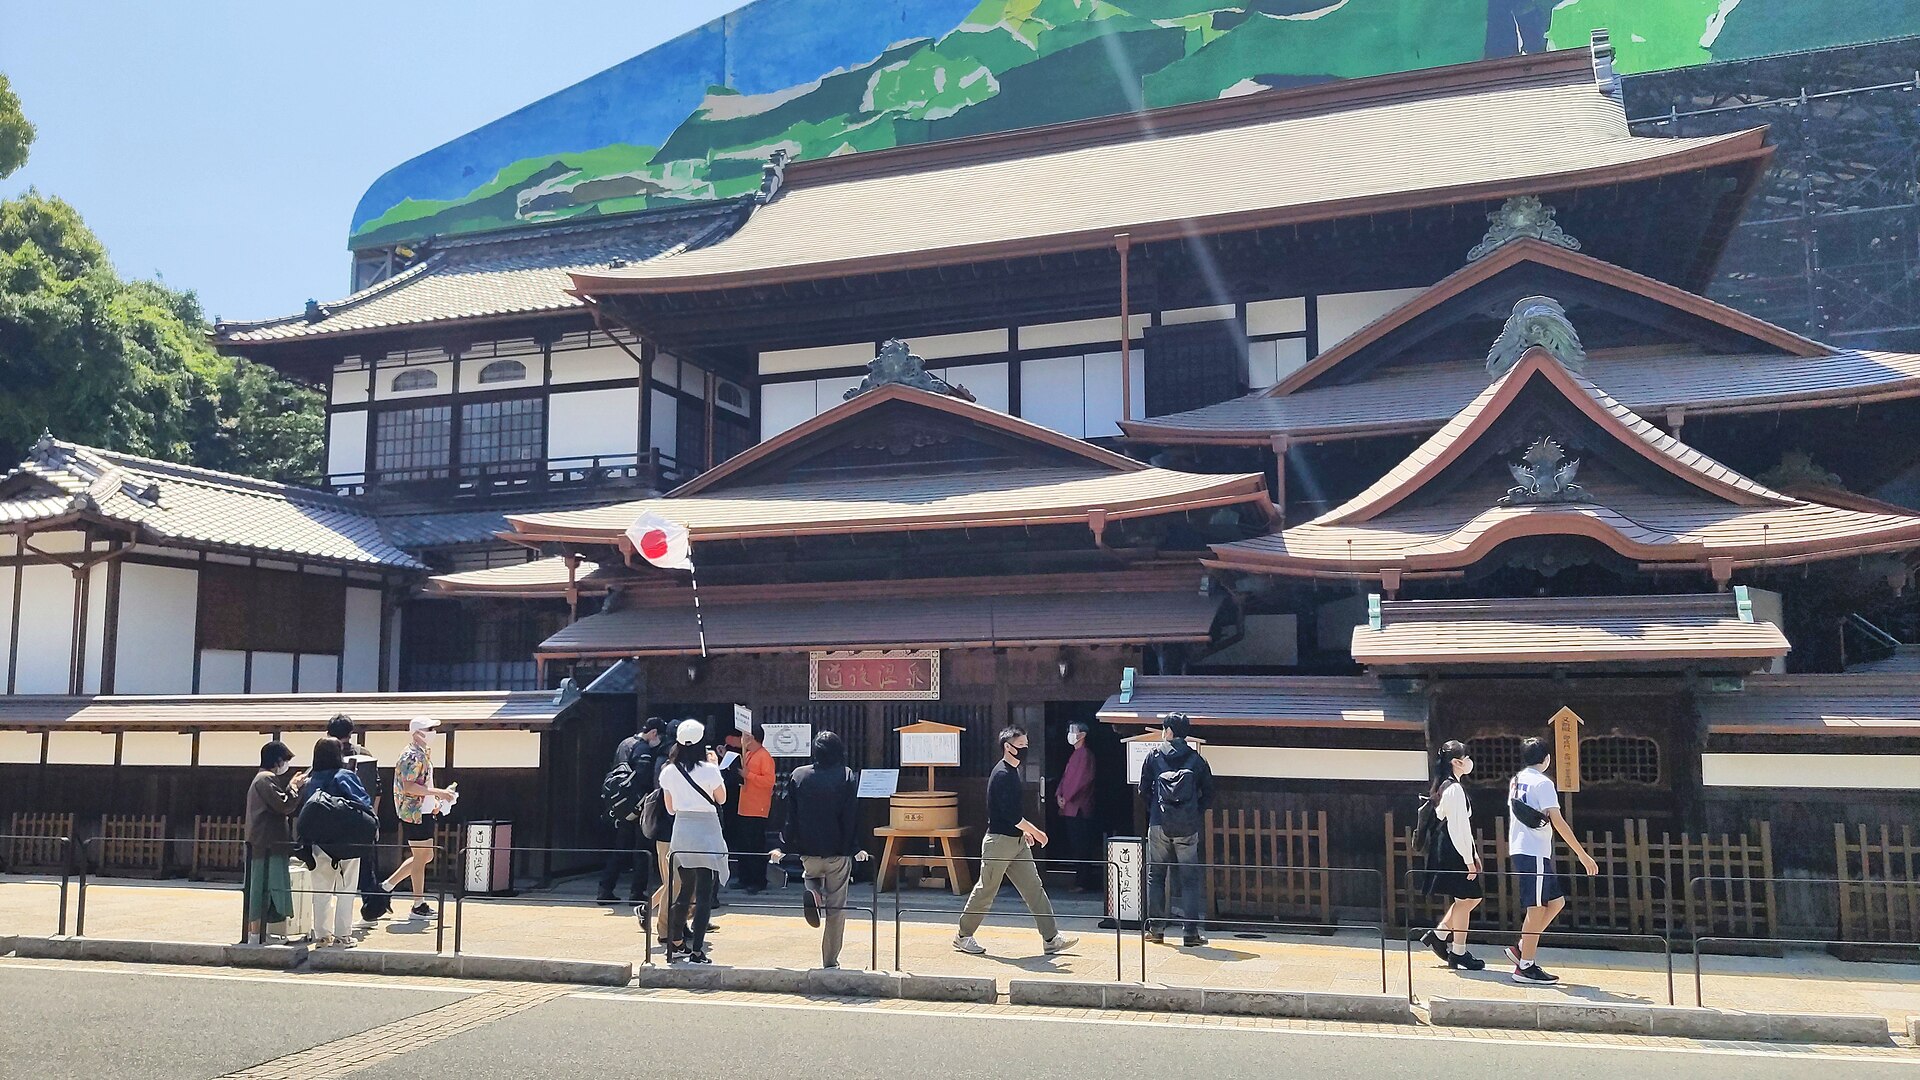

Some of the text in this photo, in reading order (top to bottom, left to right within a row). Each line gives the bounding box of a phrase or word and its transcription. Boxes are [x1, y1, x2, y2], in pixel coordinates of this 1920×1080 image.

[825, 663, 925, 689] 道後温泉
[1119, 847, 1132, 912] 道後温泉
